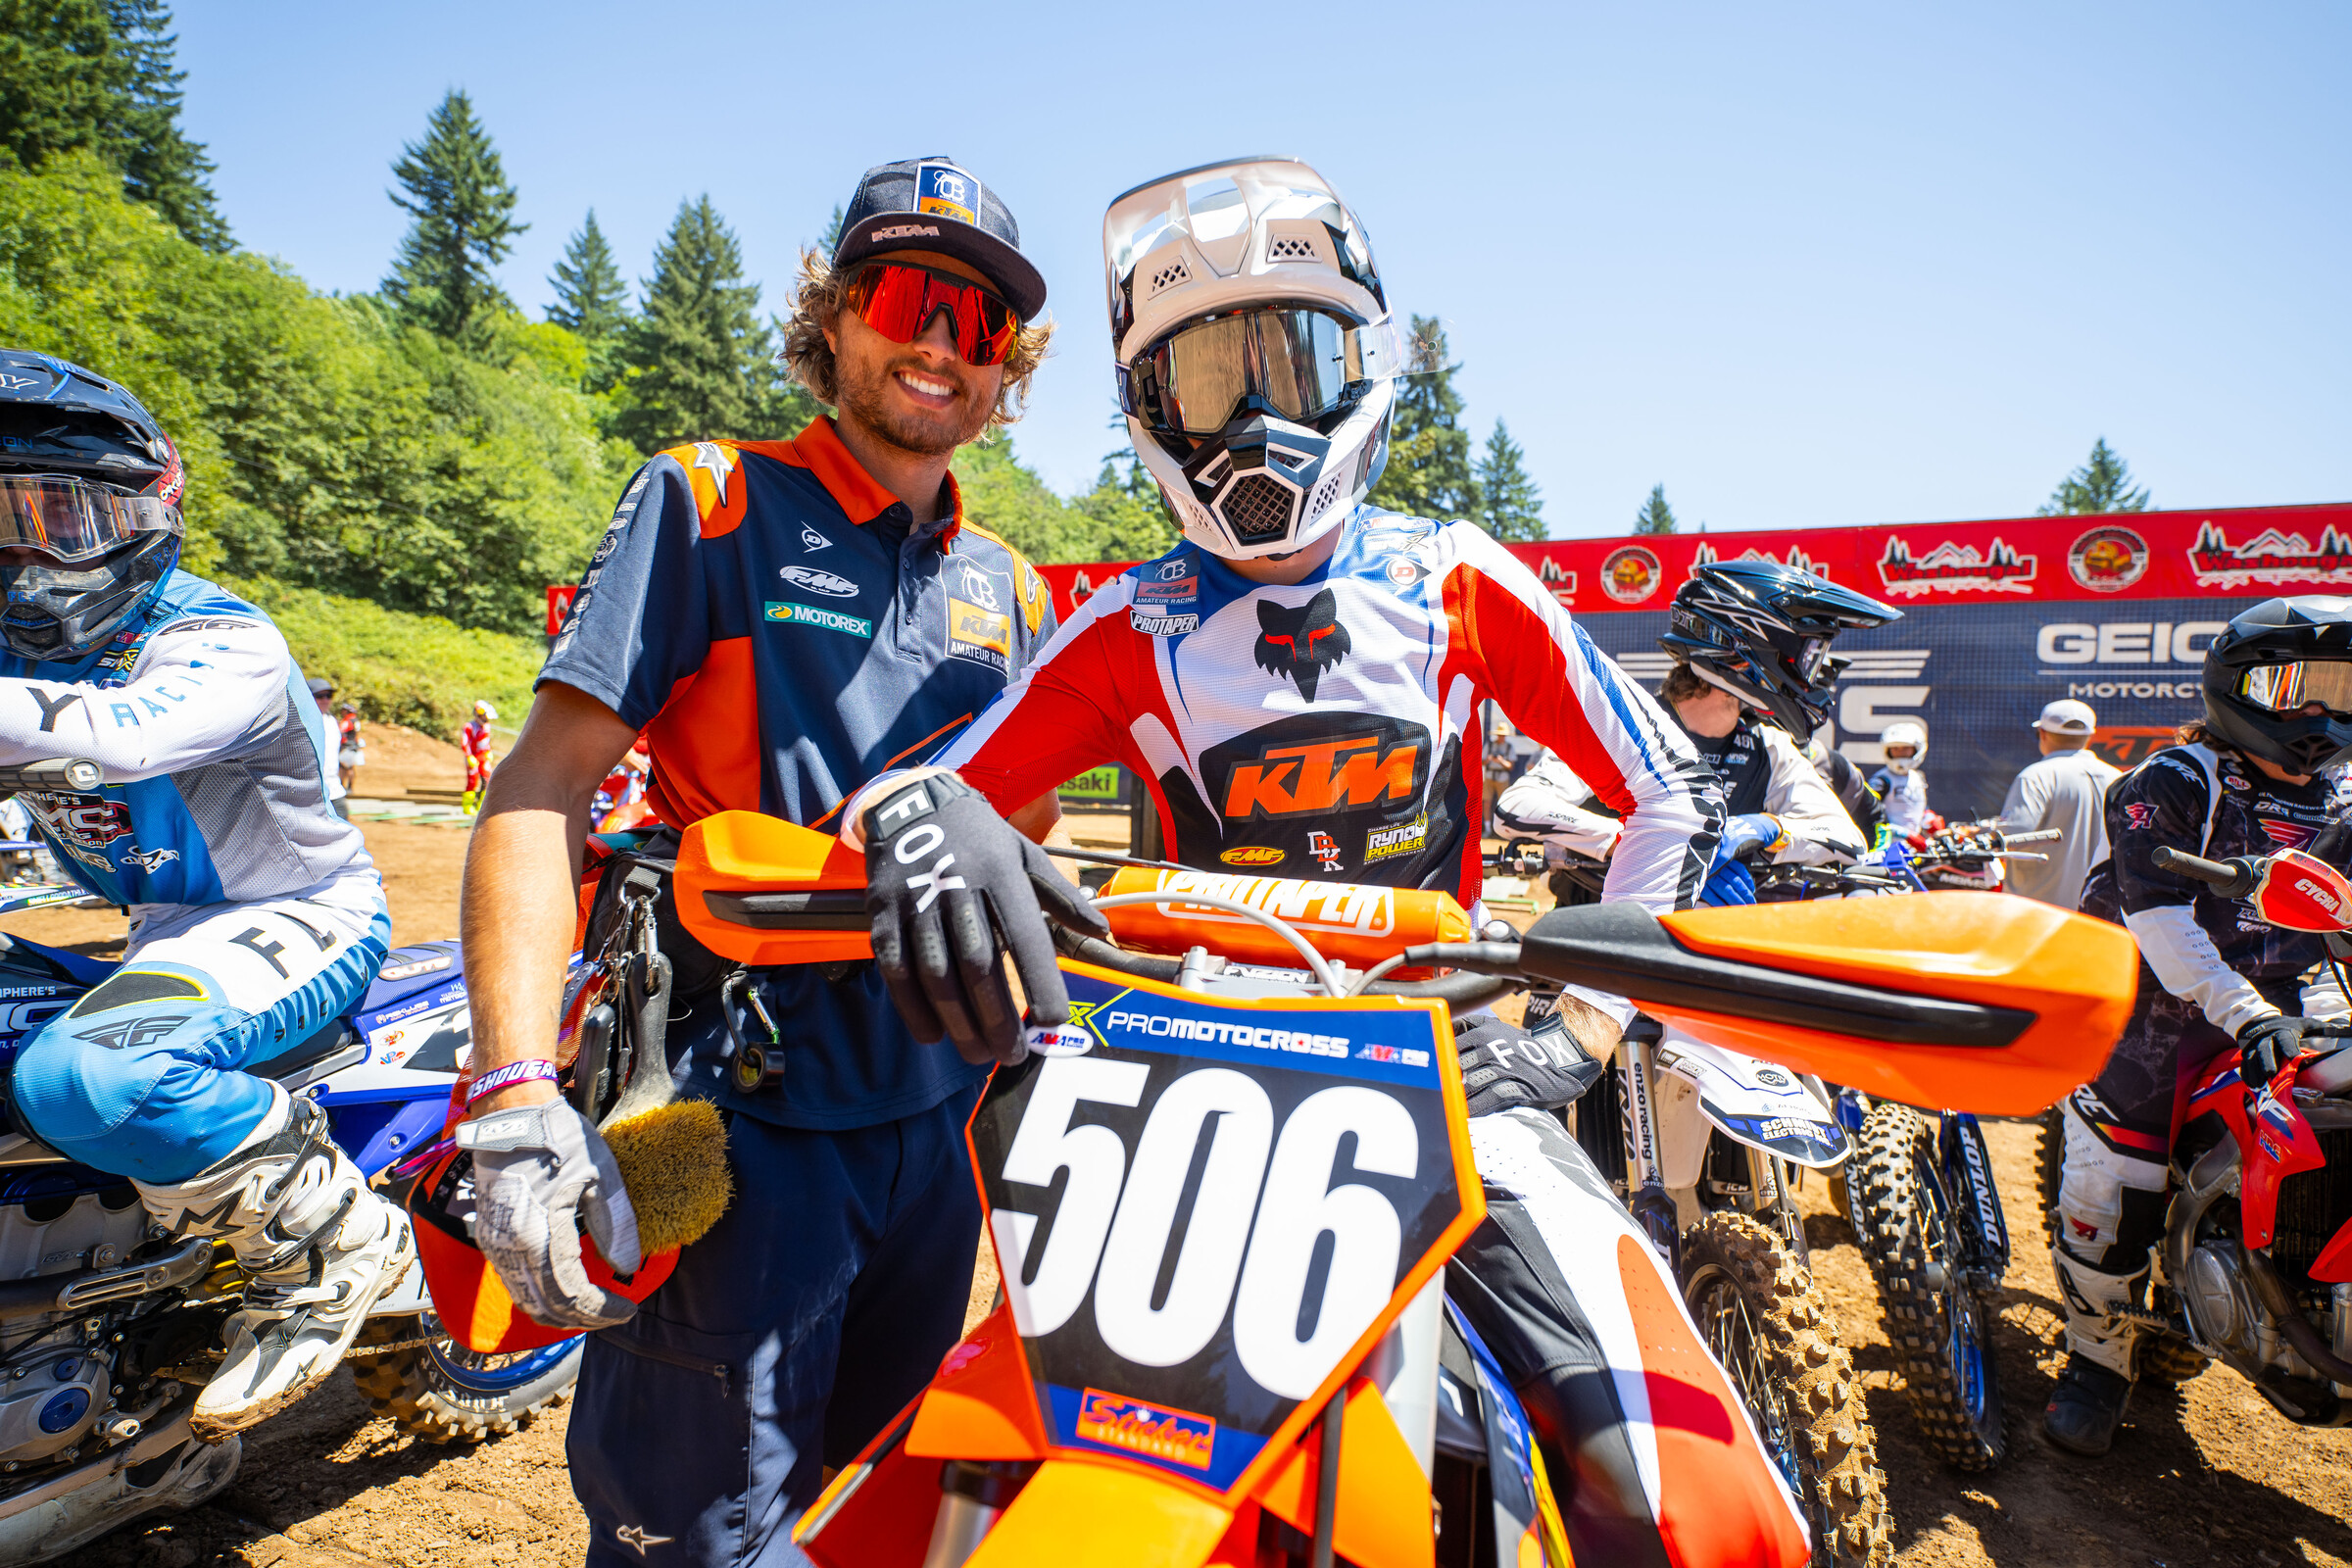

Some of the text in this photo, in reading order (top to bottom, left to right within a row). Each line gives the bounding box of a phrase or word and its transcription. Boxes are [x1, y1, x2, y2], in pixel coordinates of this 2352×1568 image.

[871, 223, 940, 242] KTM
[1884, 559, 2033, 582] Washougal
[2192, 550, 2352, 571] Washouga
[780, 566, 859, 594] FMF
[1145, 584, 1191, 595] KTM
[794, 605, 868, 636] MOTOREX
[959, 614, 1007, 644] KTM
[1133, 613, 1199, 636] PROTAPER
[951, 641, 990, 662] AMATEUR
[2036, 622, 2228, 663] GEIC
[2068, 683, 2204, 699] MOTORC
[1057, 772, 1111, 793] asaki
[1225, 736, 1418, 817] KTM
[879, 789, 967, 913] FOX
[1221, 849, 1285, 864] FMF
[1367, 836, 1423, 858] POWER
[1165, 871, 1374, 924] PROTAPER
[2294, 879, 2340, 912] CYCRA
[228, 911, 337, 980] FL
[1527, 994, 1550, 1017] PIR
[1106, 1010, 1350, 1058] PROMOTOCROSS
[1487, 1033, 1576, 1069] FOX
[1634, 1061, 1653, 1160] enzo racing
[1845, 1164, 1869, 1244] NLOP
[990, 1055, 1419, 1400] 506
